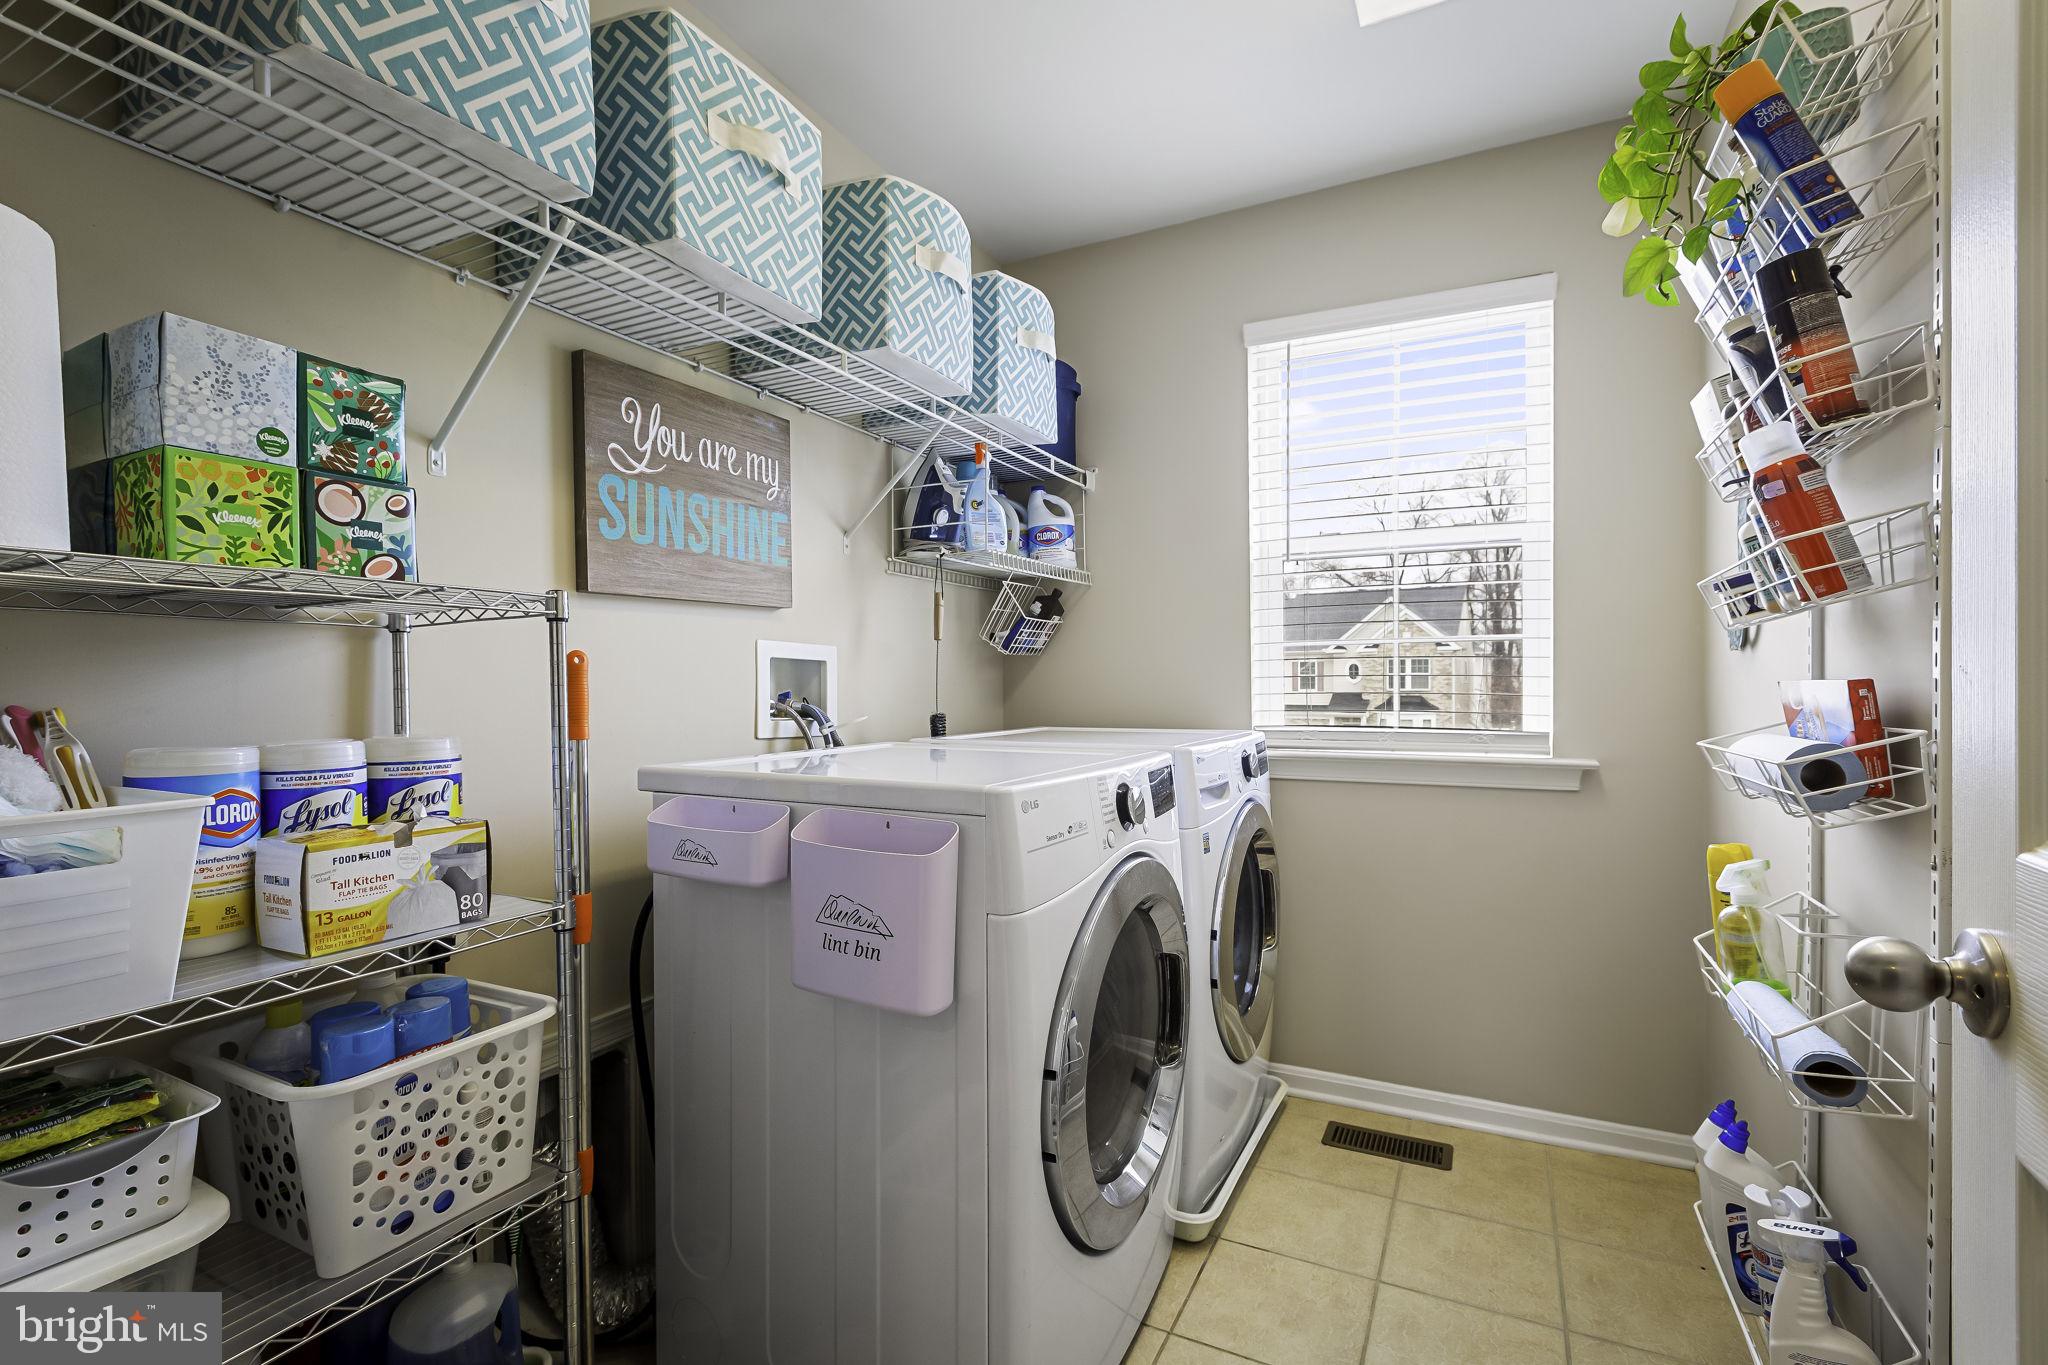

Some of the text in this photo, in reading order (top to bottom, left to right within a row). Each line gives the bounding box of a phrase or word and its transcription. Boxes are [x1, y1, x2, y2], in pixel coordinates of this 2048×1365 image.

[1754, 99, 1785, 119] Static
[1757, 104, 1792, 128] GUARD
[337, 412, 379, 432] Kleenex
[258, 432, 287, 445] Kleenex
[607, 396, 780, 501] You are my
[212, 510, 262, 528] Kleenex
[598, 474, 791, 567] SUNSHINE
[346, 526, 384, 542] Kleenex
[1036, 531, 1060, 541] CLOROX
[203, 800, 257, 826] LOROX
[283, 790, 352, 834] Lysol
[1029, 799, 1039, 810] LG
[333, 854, 357, 866] FOOD
[371, 849, 391, 859] LION
[194, 866, 213, 875] .9%
[330, 873, 395, 891] Tall Kitchen
[338, 889, 355, 897] FLAP
[369, 883, 388, 892] BAGS
[460, 892, 484, 910] 80
[225, 906, 237, 916] 85
[315, 910, 372, 926] 13 GALLON
[461, 909, 483, 919] BAGS
[822, 932, 881, 962] lint bin
[1773, 1222, 1825, 1236] Bona
